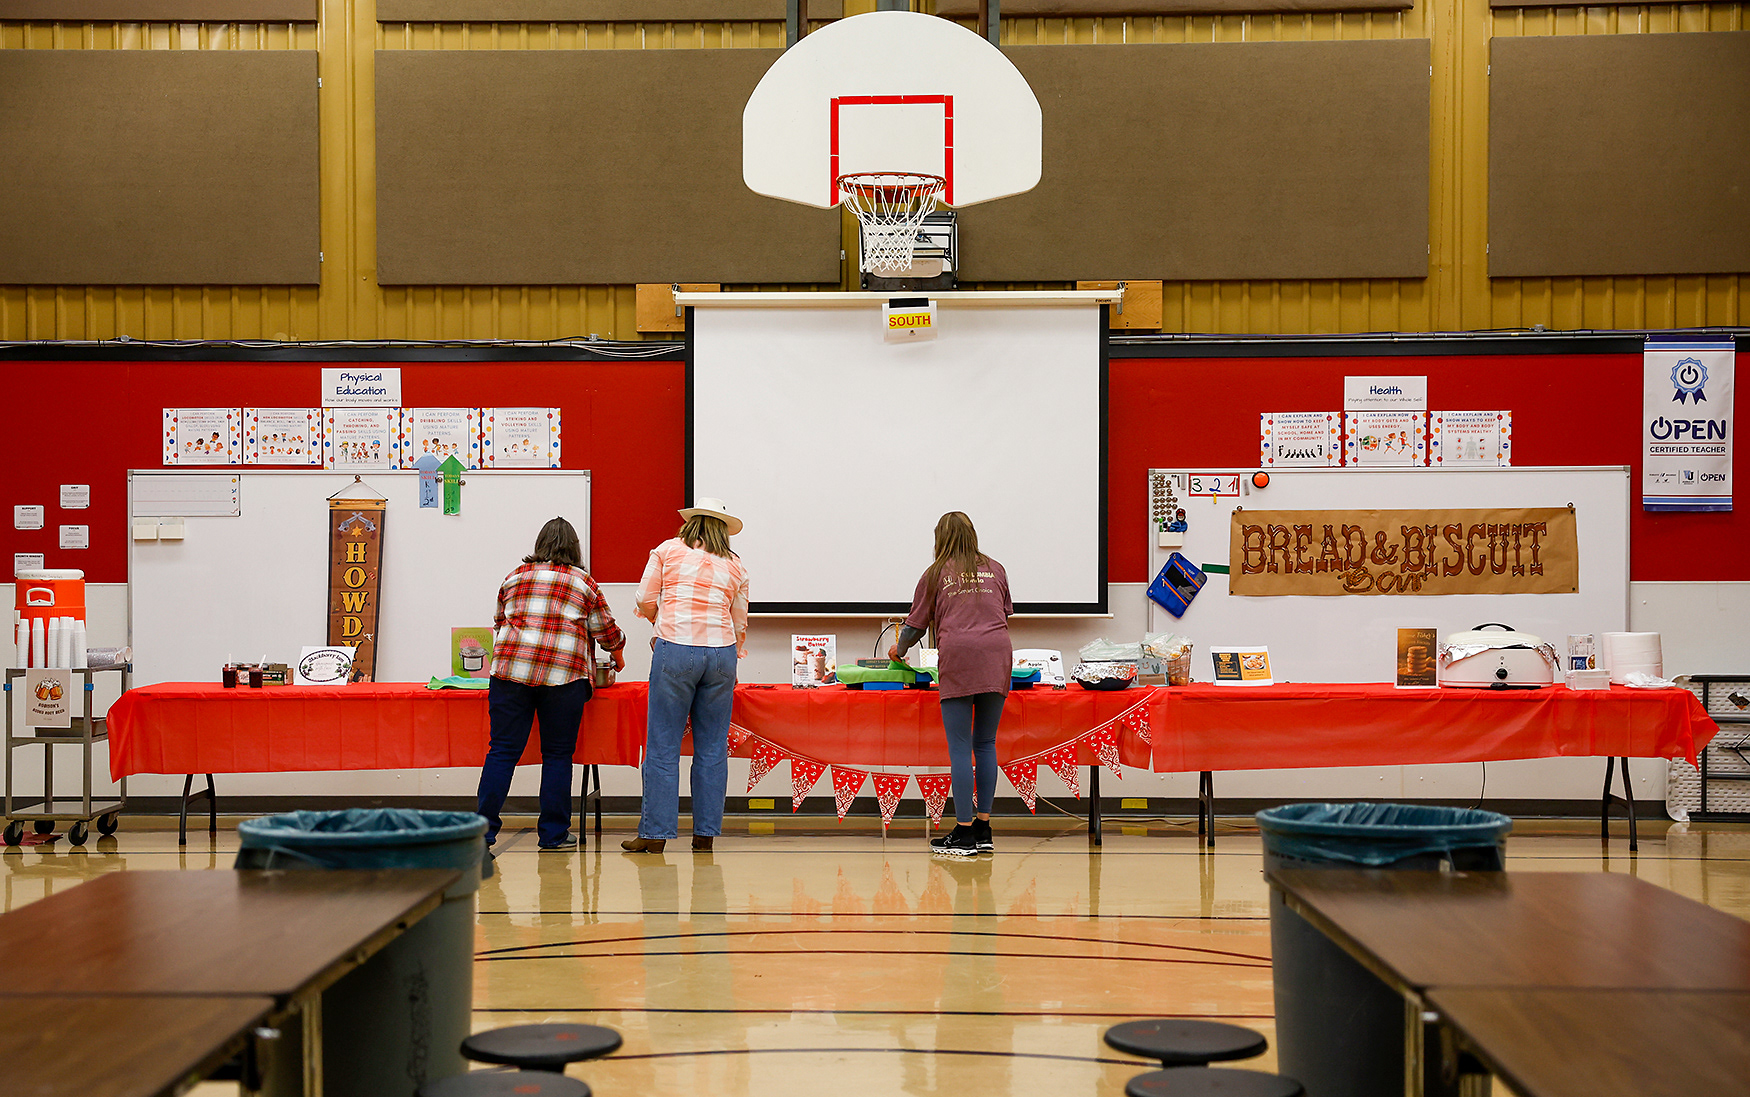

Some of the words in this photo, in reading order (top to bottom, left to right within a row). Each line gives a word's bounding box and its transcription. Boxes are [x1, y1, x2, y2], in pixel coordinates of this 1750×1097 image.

[889, 315, 931, 327] SOUTH
[340, 373, 382, 386] Physical
[336, 385, 387, 395] Education
[1369, 385, 1403, 395] Health
[1650, 416, 1727, 440] OPEN
[1700, 473, 1726, 482] OPEN
[1192, 478, 1203, 492] 3
[1209, 478, 1221, 492] 2
[1227, 477, 1236, 492] 1
[1241, 524, 1366, 575] BREAD
[1370, 530, 1399, 566] &
[1401, 522, 1548, 577] BISCUIT
[1336, 566, 1428, 593] Bar
